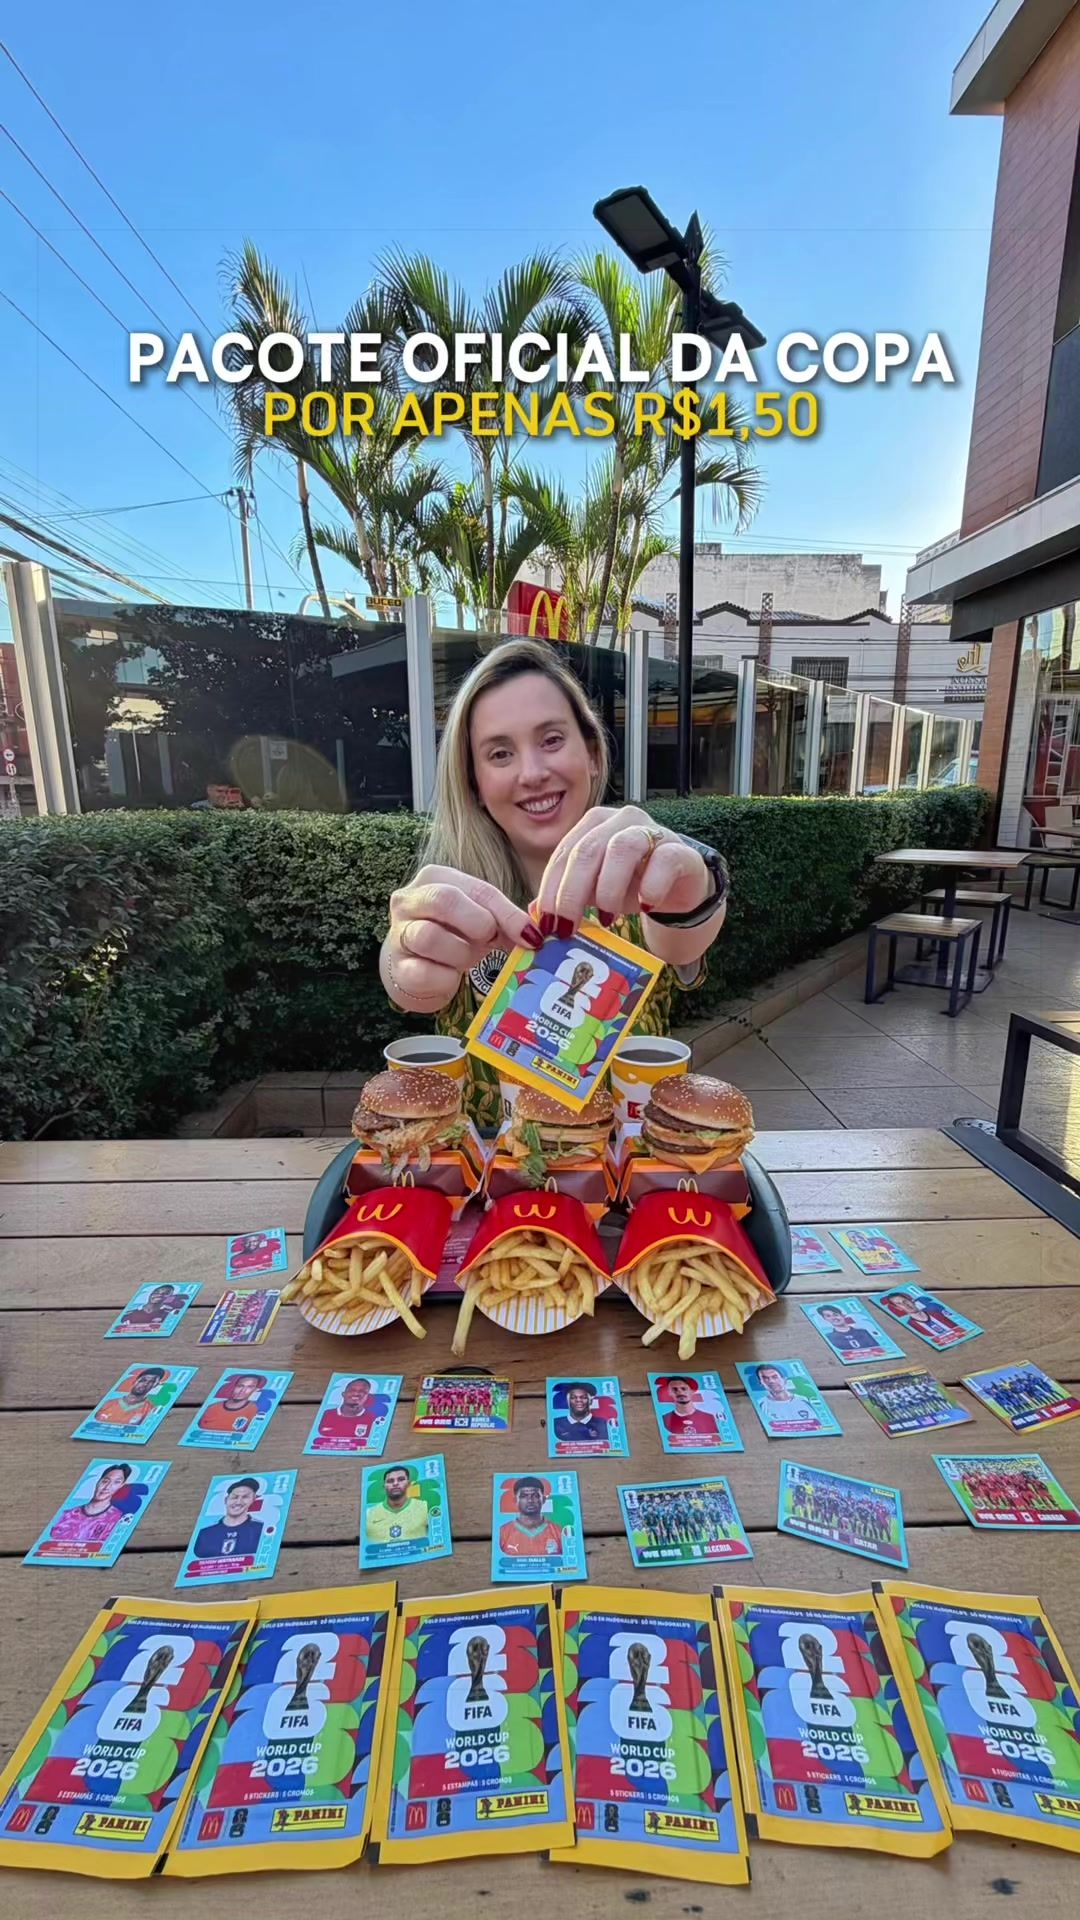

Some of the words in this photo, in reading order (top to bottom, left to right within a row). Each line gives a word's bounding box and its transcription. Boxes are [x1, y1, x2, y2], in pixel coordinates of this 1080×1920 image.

[551, 1003, 572, 1020] FIFA
[532, 1011, 559, 1032] WORLD
[559, 1028, 575, 1040] CUP
[524, 1020, 571, 1050] 2026
[546, 1064, 577, 1084] PANINI
[464, 1705, 493, 1720] FIFA
[810, 1703, 841, 1718] FIFA
[987, 1701, 1021, 1717] FIFA
[113, 1717, 142, 1731] FIFA
[280, 1715, 309, 1728] FIFA
[628, 1716, 657, 1731] FIFA
[445, 1735, 485, 1748] WORLD
[487, 1732, 510, 1744] CUP
[798, 1727, 840, 1742] WORLD
[841, 1732, 864, 1744] CUP
[978, 1724, 1023, 1741] WORLD
[1023, 1732, 1048, 1745] CUP
[83, 1744, 124, 1758] WORLD
[124, 1747, 147, 1759] CUP
[256, 1744, 297, 1757] WORLD
[298, 1742, 322, 1754] CUP
[444, 1745, 510, 1770] 2026
[610, 1743, 651, 1757] WORLD
[652, 1746, 675, 1759] CUP
[801, 1740, 870, 1764] 2026
[983, 1738, 1057, 1765] 2026
[70, 1758, 139, 1780] 2026
[249, 1756, 319, 1778] 2026
[610, 1757, 677, 1780] 2026
[496, 1794, 545, 1809] PANINI
[864, 1797, 917, 1813] PANINI
[293, 1808, 344, 1821] PANINI
[98, 1817, 148, 1831] PANINI
[664, 1815, 715, 1832] PANINI
